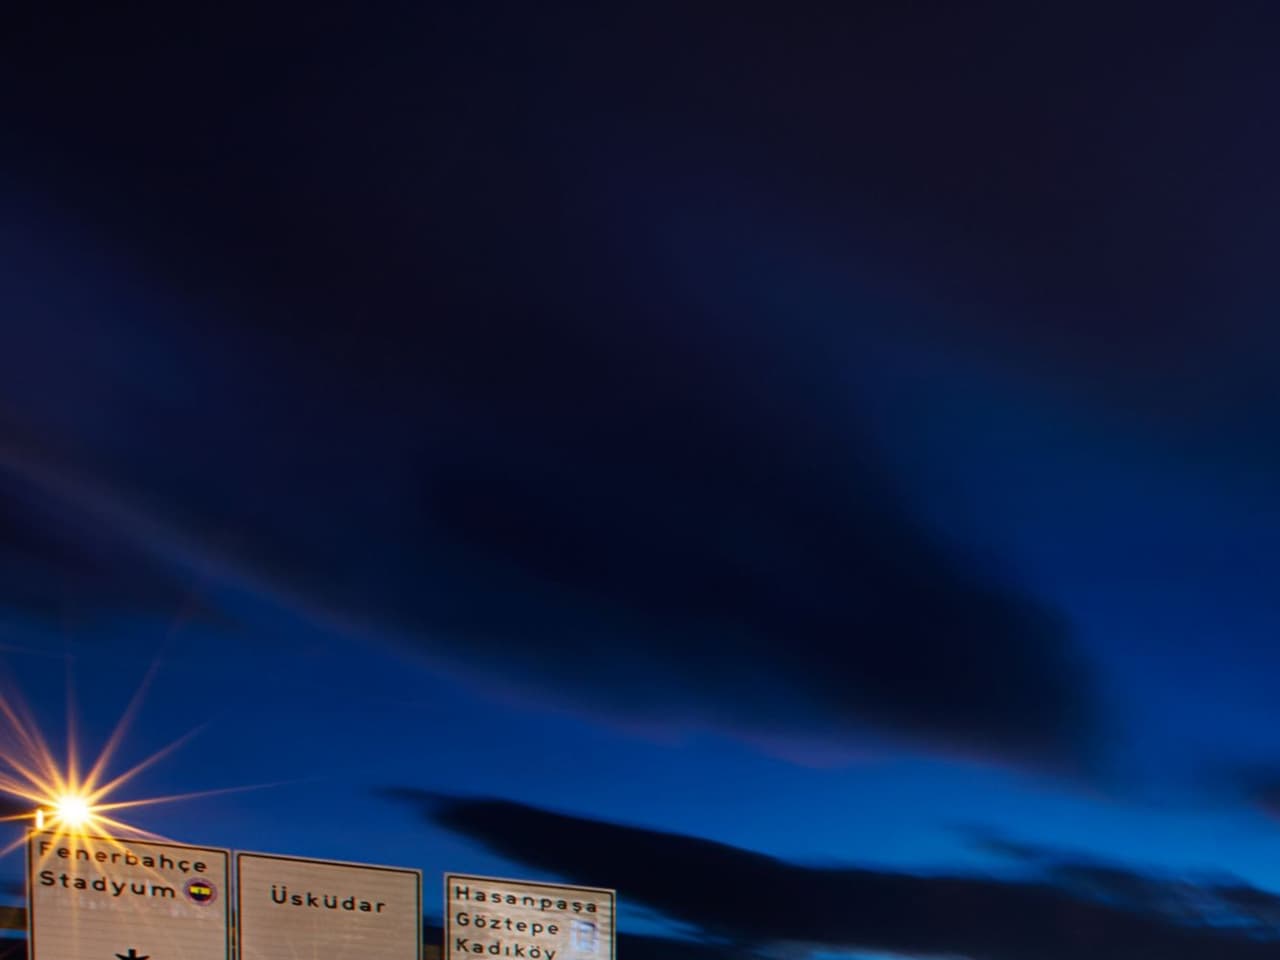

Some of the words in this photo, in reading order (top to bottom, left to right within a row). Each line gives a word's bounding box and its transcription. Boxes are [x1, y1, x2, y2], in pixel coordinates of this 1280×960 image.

[38, 840, 208, 873] Fenerbahçe
[39, 870, 177, 899] Stadyum
[271, 884, 387, 913] Üsküdar
[455, 885, 598, 914] Hasanpaşa
[456, 911, 560, 937] Göztepe
